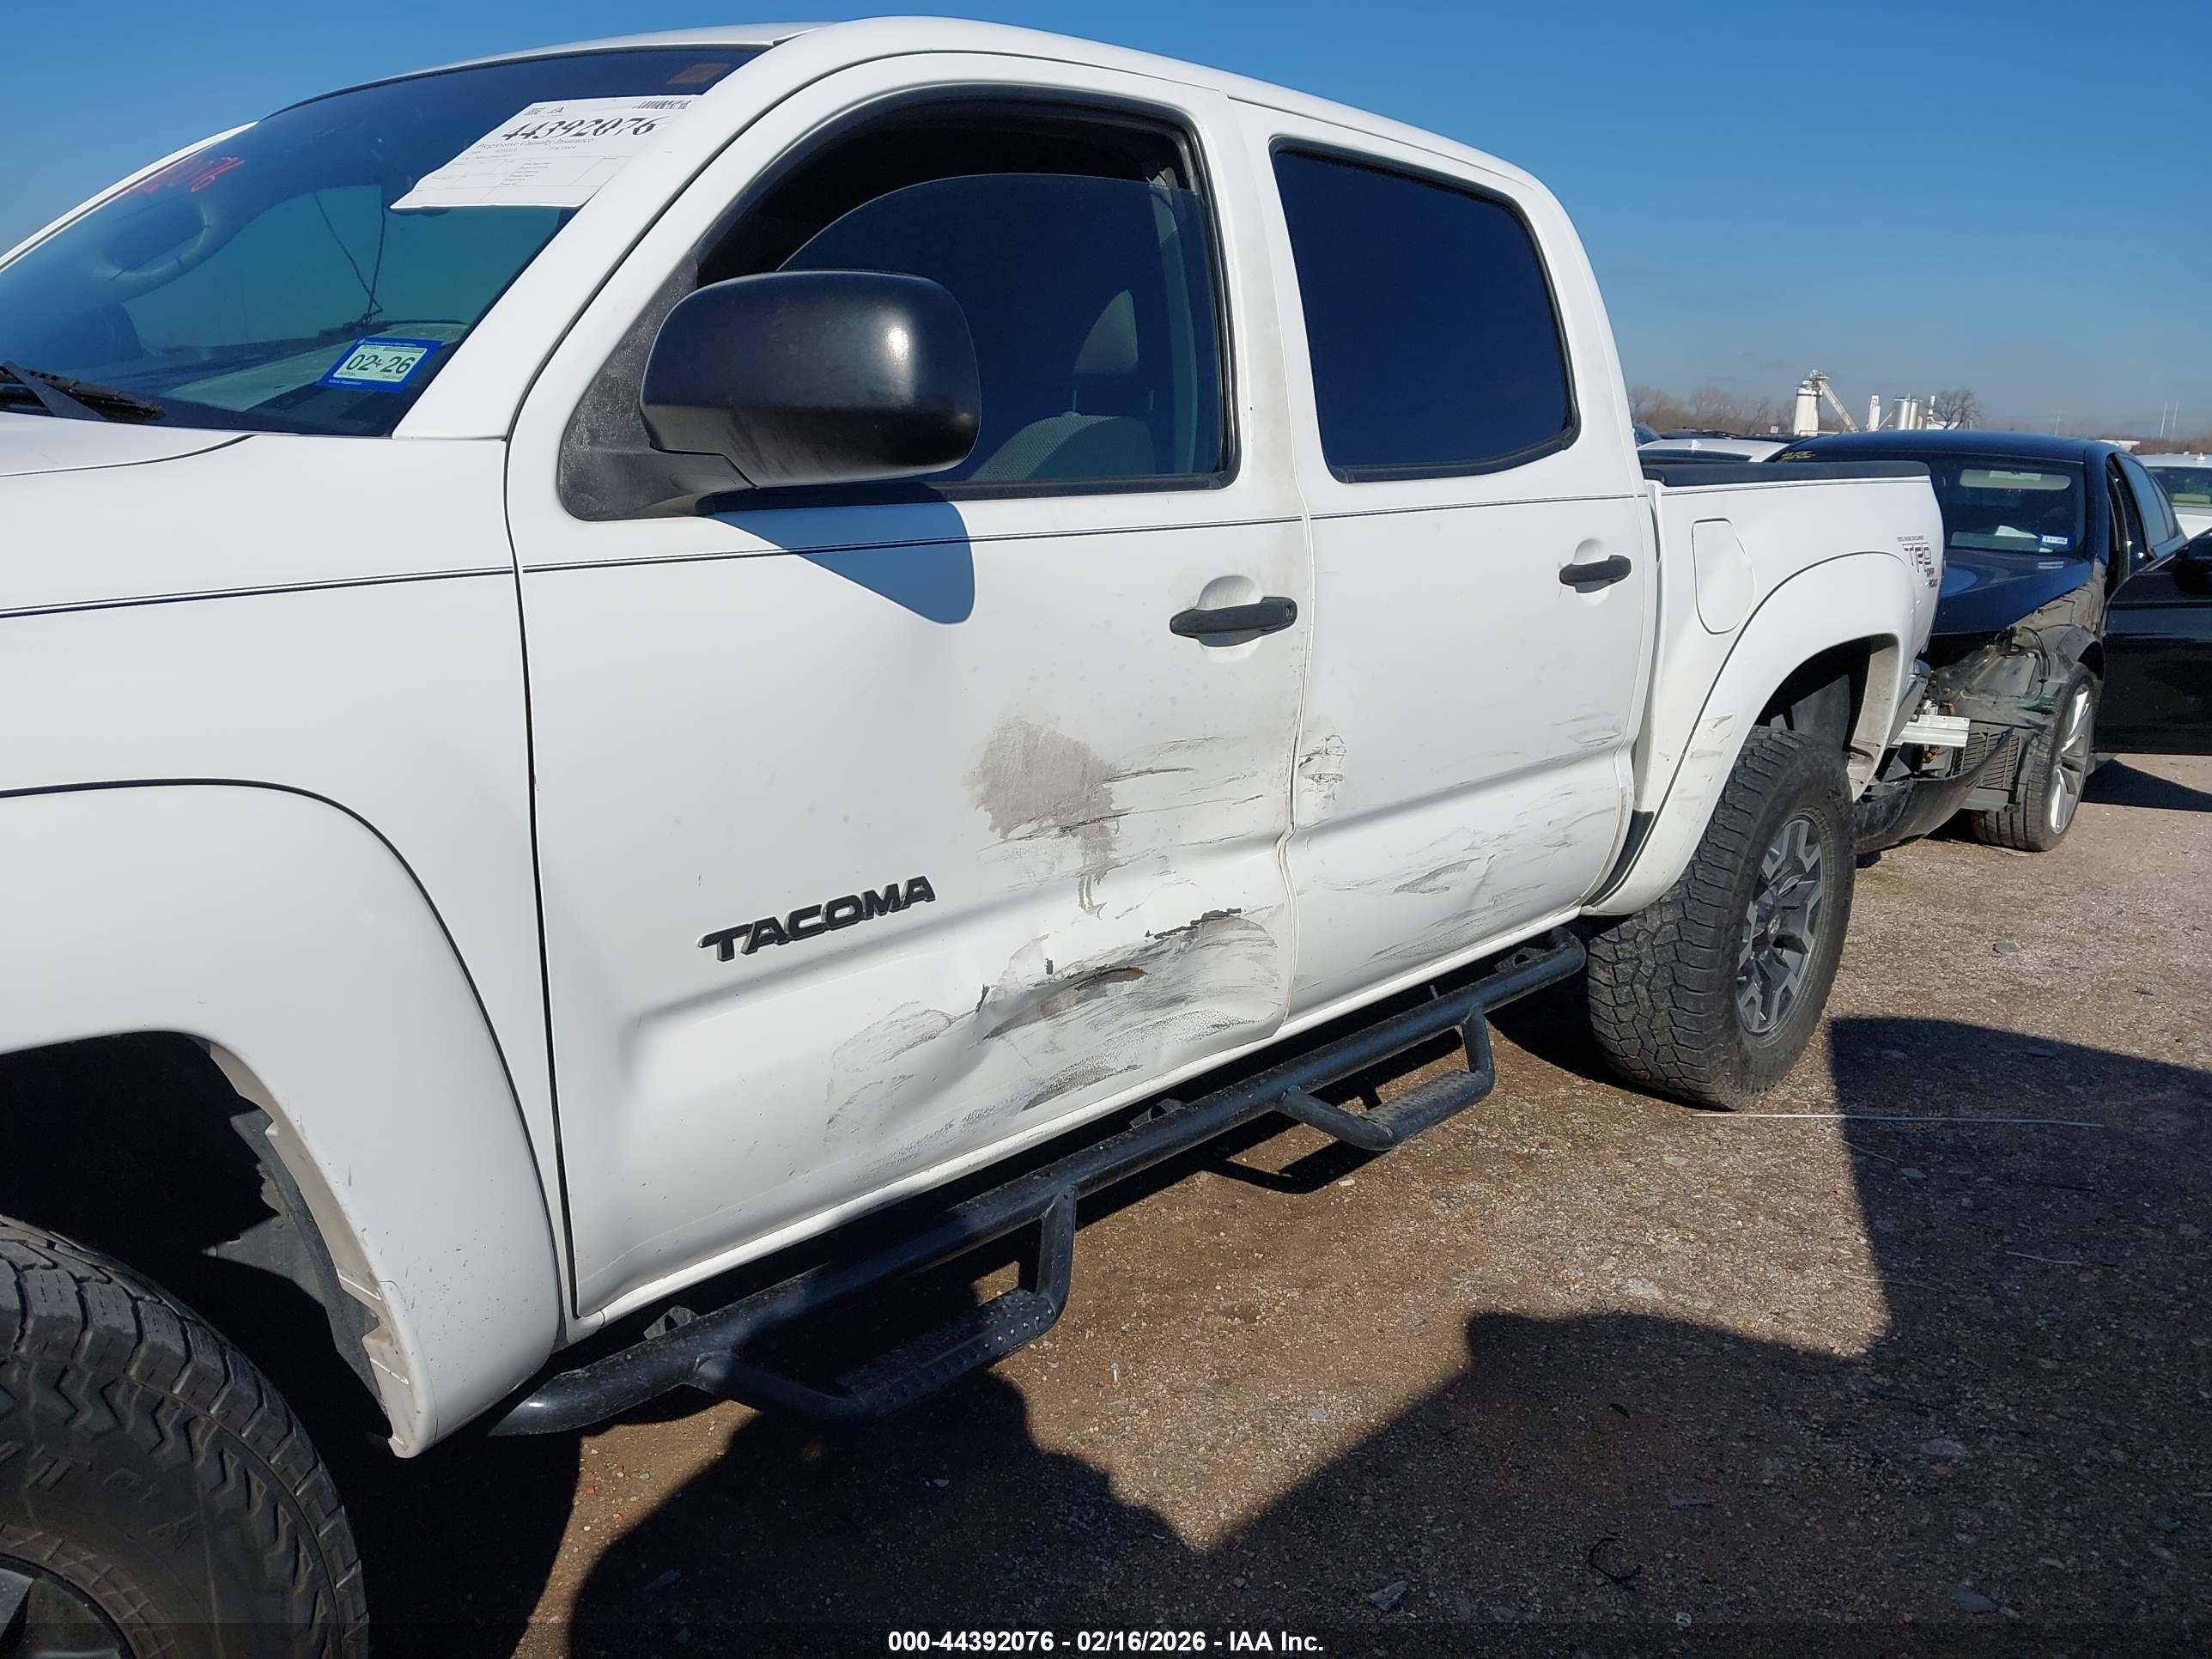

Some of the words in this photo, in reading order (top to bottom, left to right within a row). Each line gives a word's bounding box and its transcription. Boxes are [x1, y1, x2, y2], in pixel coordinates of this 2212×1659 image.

[501, 117, 668, 142] 44392076
[346, 354, 379, 371] 02
[380, 356, 416, 374] 26
[697, 875, 936, 963] TACOMA
